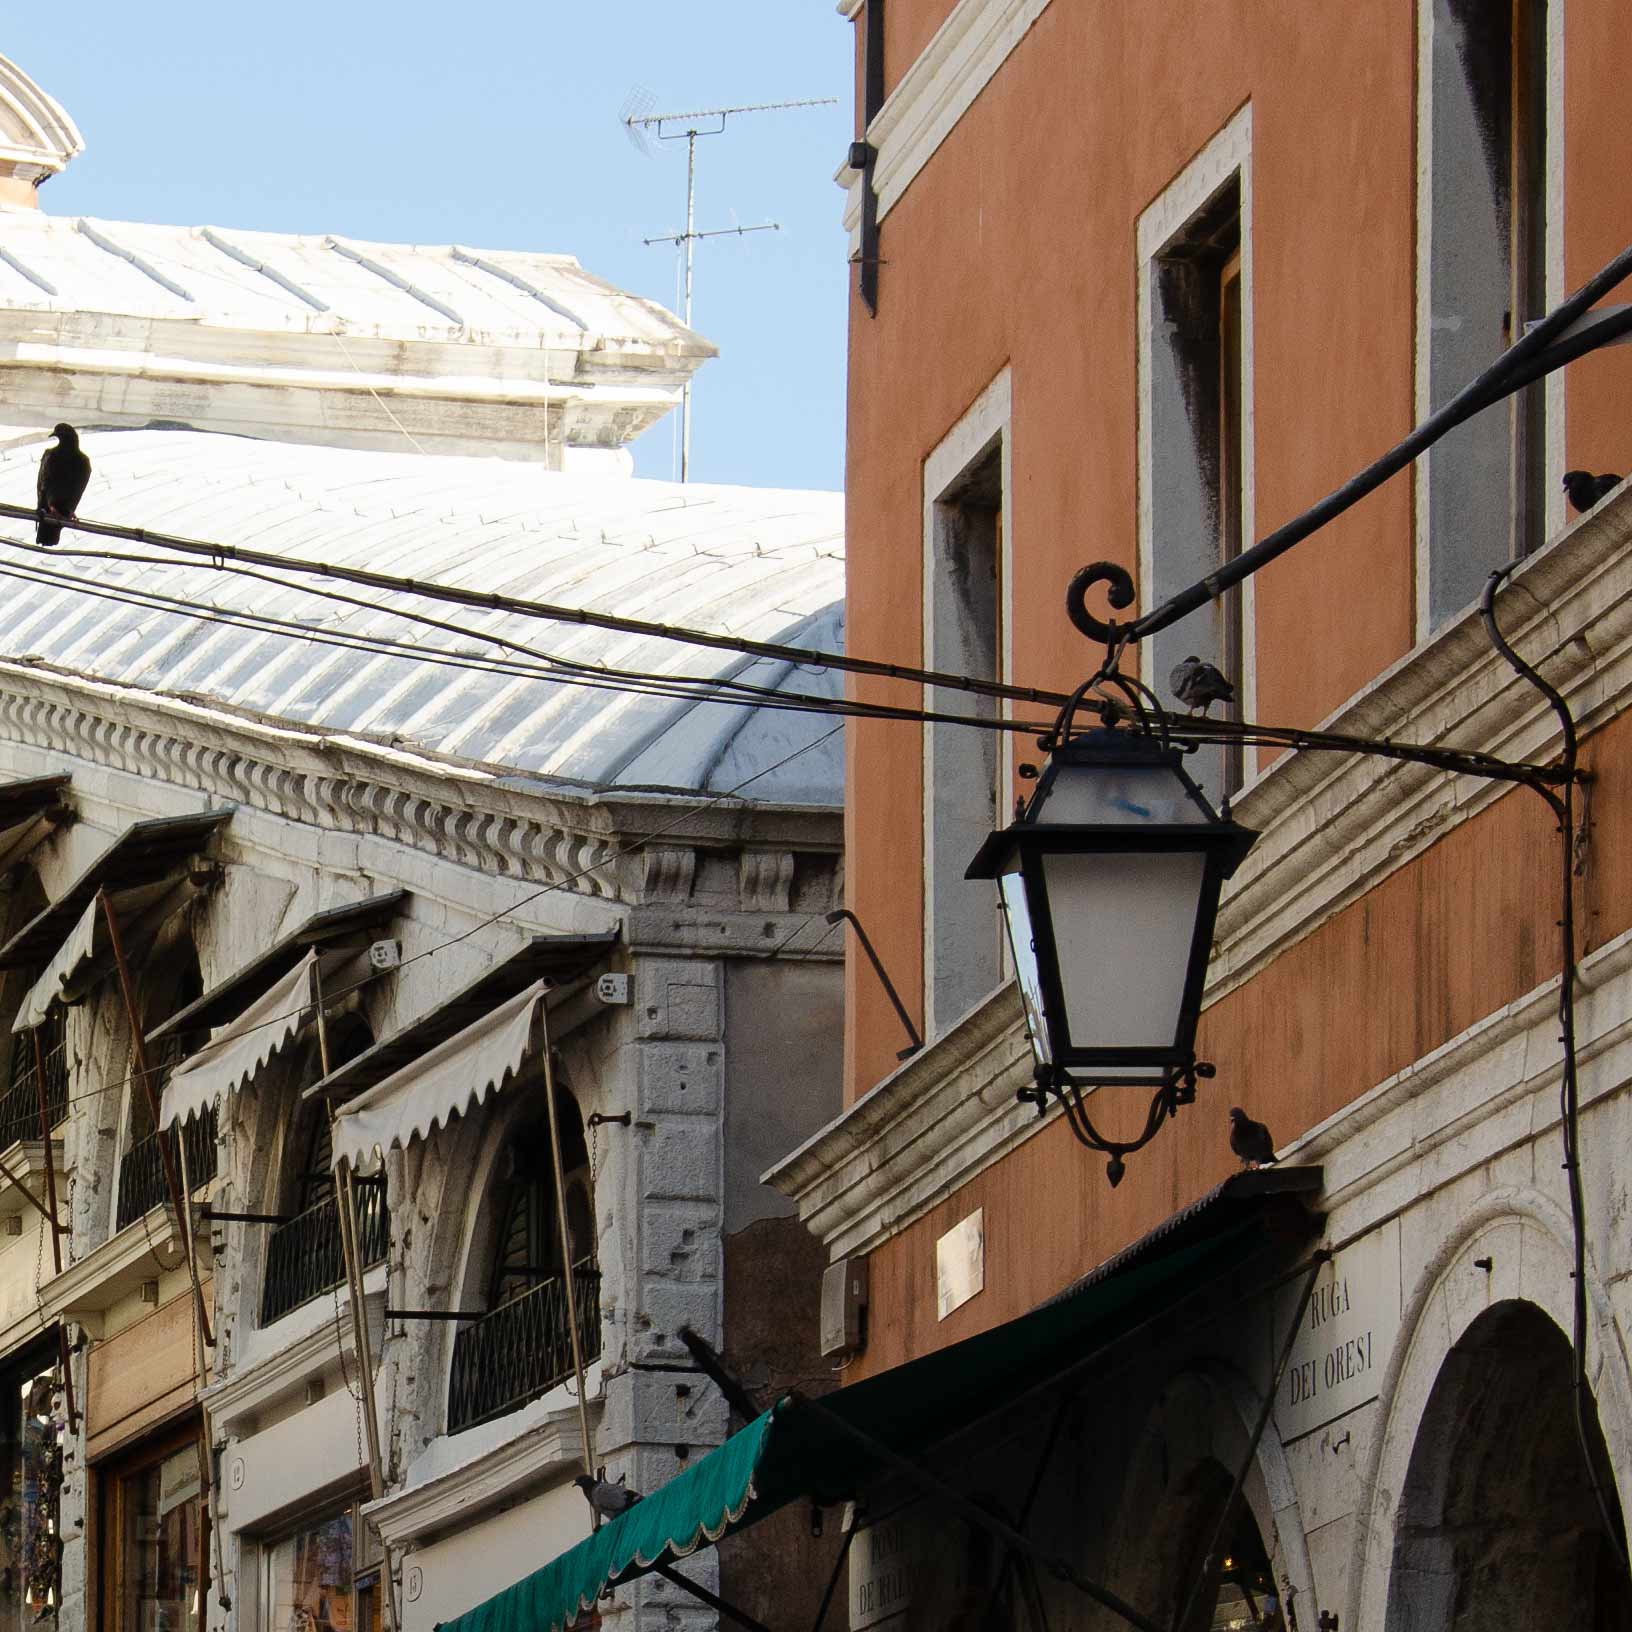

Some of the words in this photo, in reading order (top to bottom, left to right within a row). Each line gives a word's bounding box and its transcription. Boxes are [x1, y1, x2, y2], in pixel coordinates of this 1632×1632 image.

[1311, 1277, 1350, 1329] RUGA
[1290, 1359, 1316, 1406] DEI
[1325, 1332, 1372, 1389] ORESI
